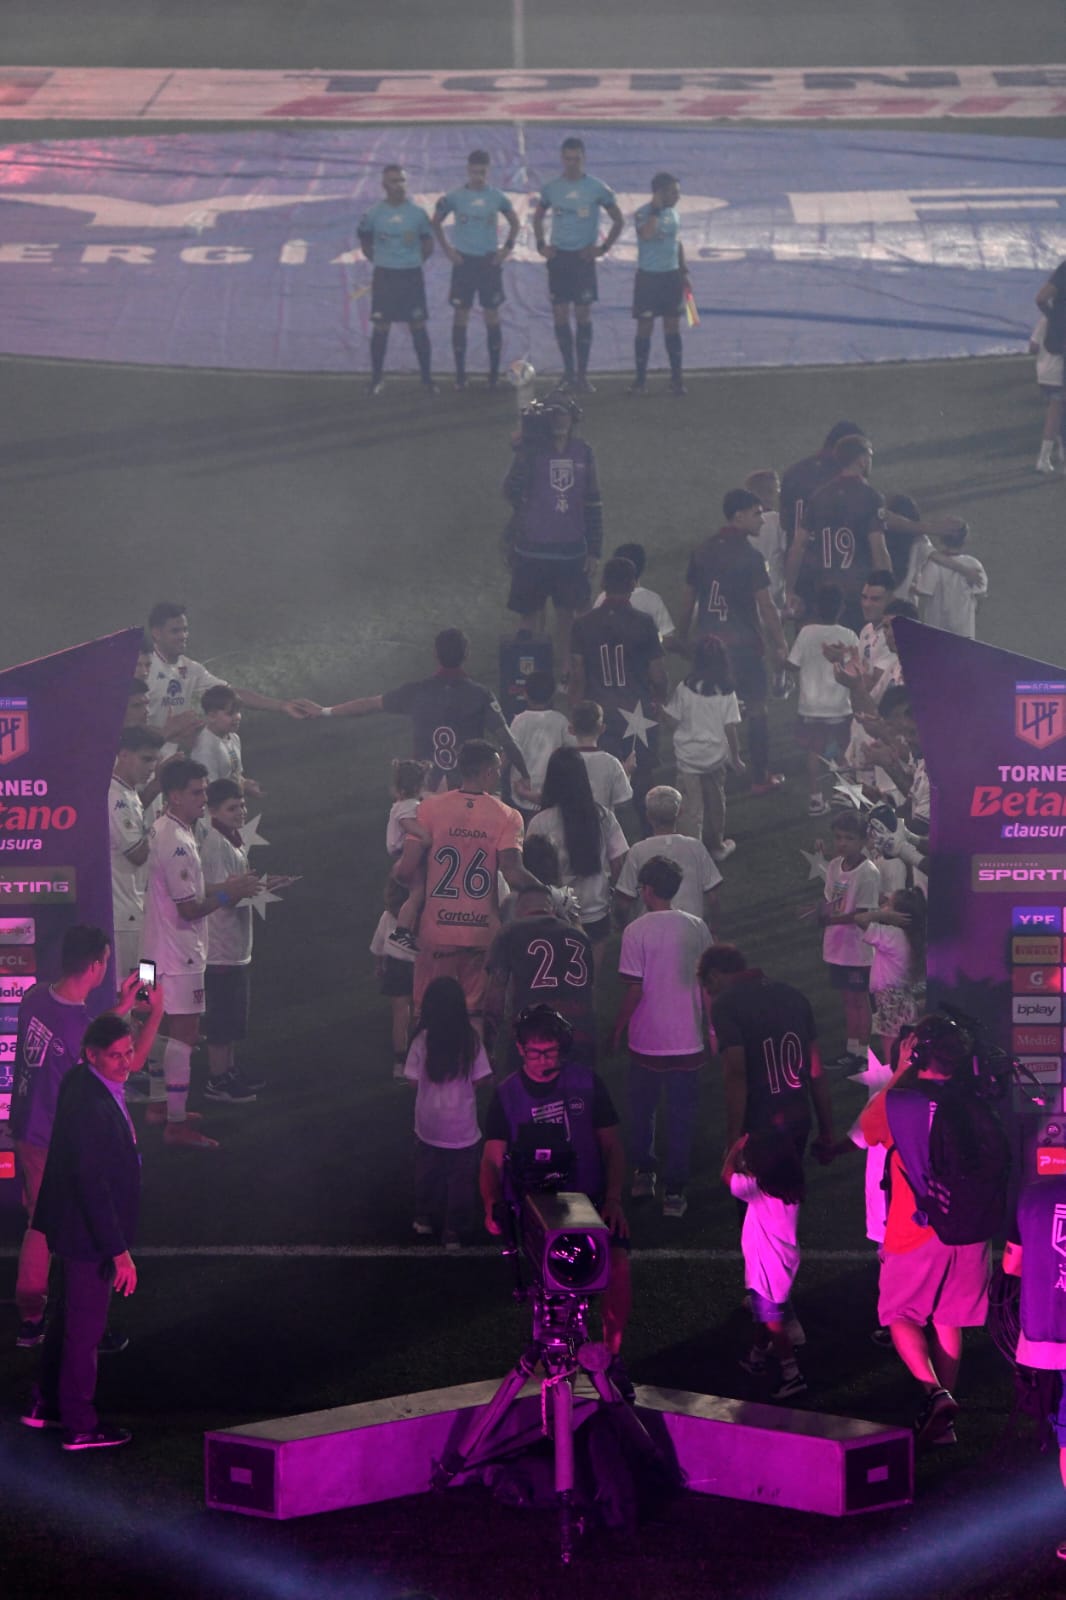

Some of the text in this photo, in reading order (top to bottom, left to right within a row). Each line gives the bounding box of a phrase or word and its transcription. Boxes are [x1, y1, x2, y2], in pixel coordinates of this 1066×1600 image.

[822, 527, 856, 569] 19
[707, 579, 736, 622] 4
[600, 644, 627, 687] 11
[433, 726, 458, 770] 8
[448, 829, 488, 840] LOSADA
[431, 846, 491, 899] 26
[1019, 914, 1056, 925] YPF
[527, 938, 588, 989] 23
[1017, 1003, 1057, 1017] bplay
[763, 1031, 803, 1094] 10
